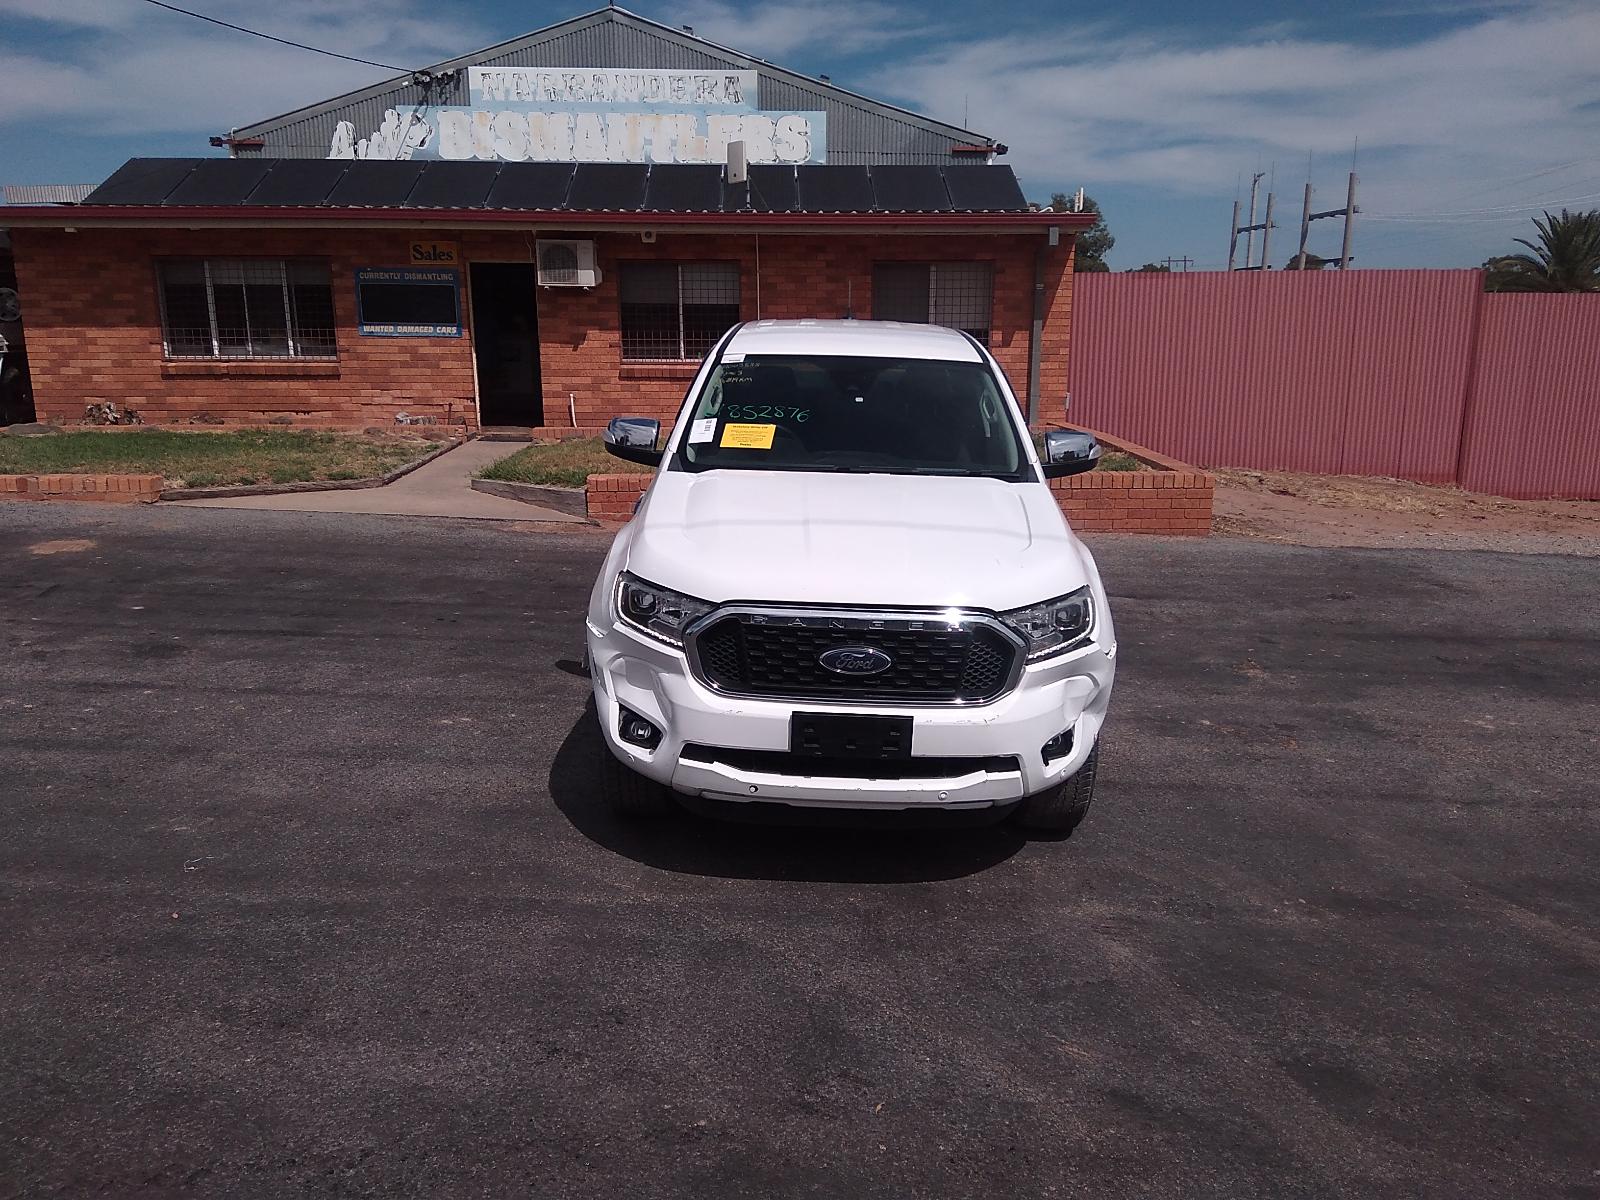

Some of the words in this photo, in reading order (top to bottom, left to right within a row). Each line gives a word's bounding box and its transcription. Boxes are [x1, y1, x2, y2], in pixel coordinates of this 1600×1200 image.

[481, 73, 744, 104] NARRANDERA
[412, 245, 454, 261] Sales
[360, 272, 401, 280] CURRENTLY
[404, 273, 454, 281] DISMANTLING
[834, 651, 875, 670] Ford
